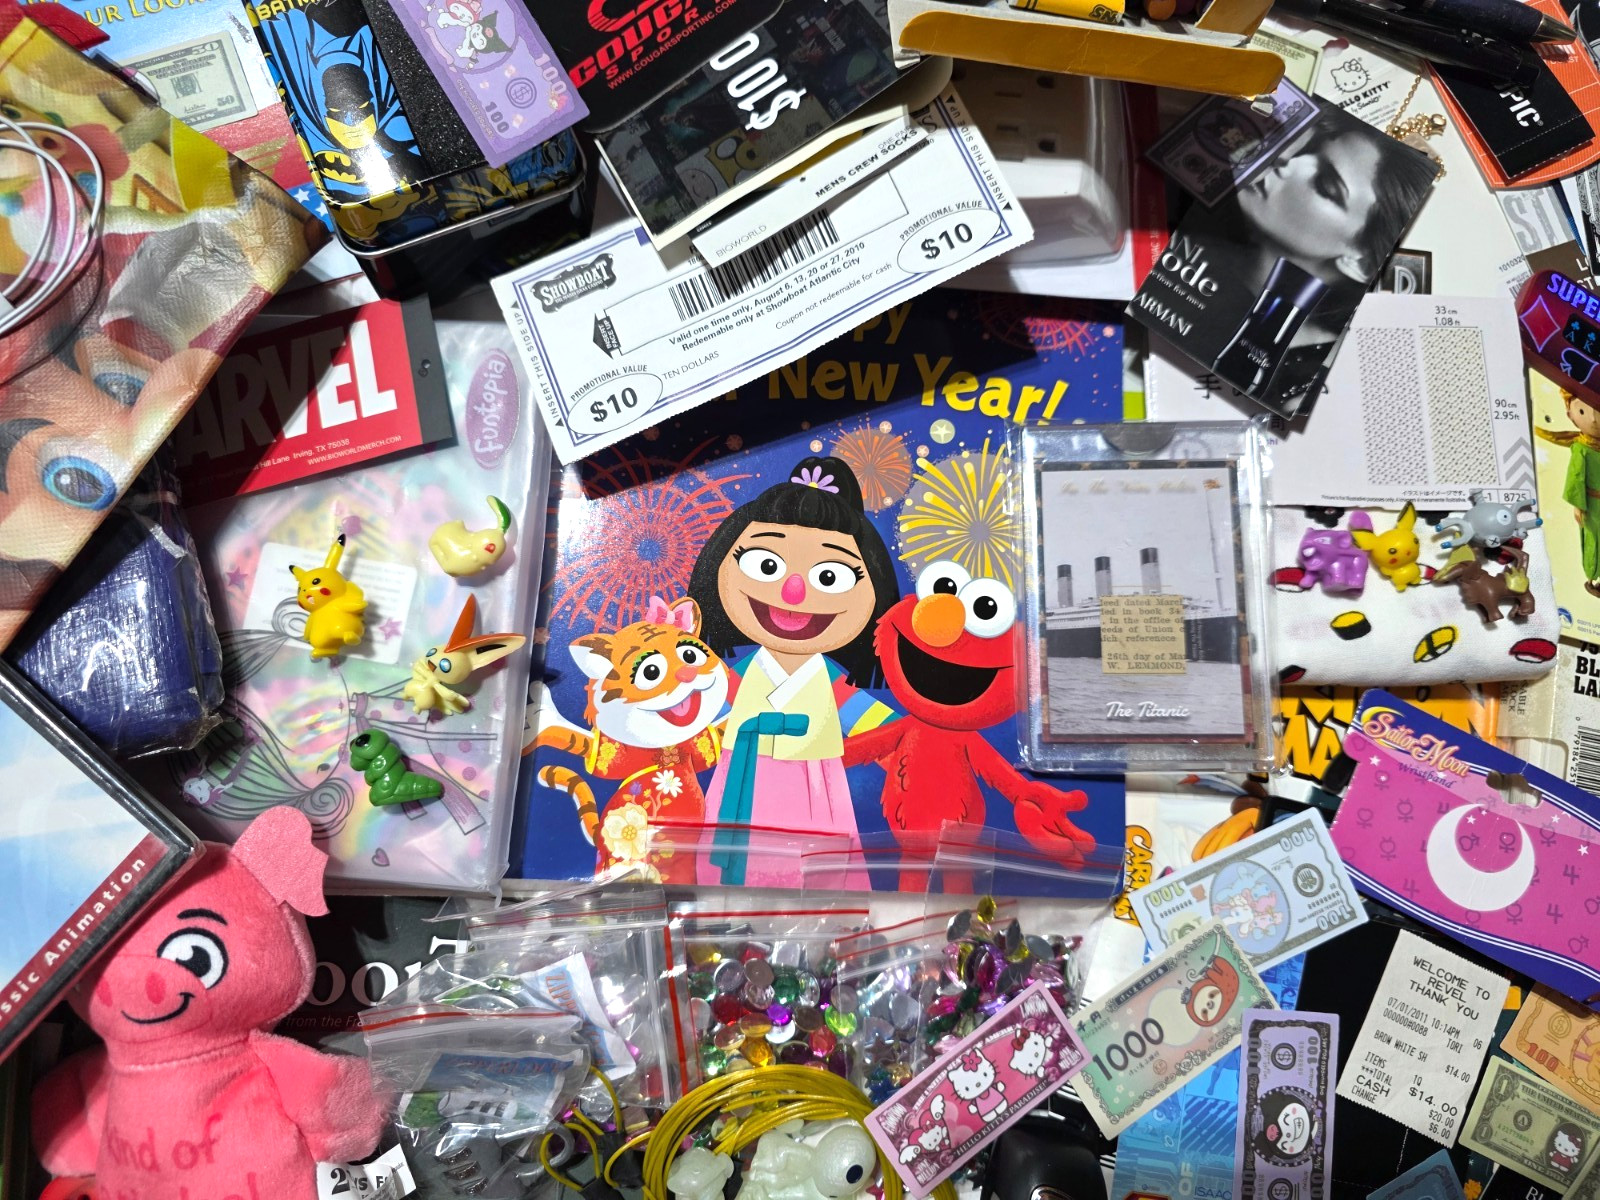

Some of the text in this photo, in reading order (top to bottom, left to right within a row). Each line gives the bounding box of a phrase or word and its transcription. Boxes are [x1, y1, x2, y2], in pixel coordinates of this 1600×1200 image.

[569, 0, 695, 89] COUG
[606, 0, 722, 80] SPOR
[607, 0, 738, 91] WWW.COUGARSPORTINC.COM
[534, 53, 567, 95] 100
[1362, 81, 1390, 99] KITTY
[485, 101, 510, 133] 100
[878, 135, 895, 149] ONE
[949, 105, 1007, 204] INSERT THIS SIDE UP
[815, 174, 847, 199] MENS
[848, 154, 880, 178] CREW
[880, 128, 919, 157] SOCKS
[898, 199, 984, 242] PROMOTIONAL VALUE
[715, 225, 767, 257] BIOWORLD
[919, 222, 974, 261] $10
[540, 259, 611, 306] SHOWBOAT
[668, 241, 866, 346] Valid one time only, August 13, 20 or 27, 2010
[775, 262, 893, 330] Coupon not redeemable for cash
[681, 257, 862, 352] Redeemable only at Showboat Atlantic City
[1132, 291, 1195, 337] ARMANI
[1434, 305, 1447, 315] 33
[1434, 317, 1454, 326] 1.08
[1565, 330, 1575, 343] A
[607, 329, 619, 349] FACE
[513, 312, 560, 419] INSERT THIS SIDE UP
[662, 350, 720, 380] TEN DOLLARS
[570, 363, 648, 402] PROMOTIONAL VALUE
[767, 352, 1071, 426] New Year!
[474, 359, 509, 453] Funtopia
[589, 386, 638, 423] $10
[259, 438, 350, 469] Hill Lane Irving, TX 75038
[307, 434, 403, 466] WWW.BIOWORLDMERCH.COM
[1503, 492, 1527, 503] 8725
[1121, 607, 1132, 616] in
[1138, 607, 1162, 616] book
[1123, 598, 1151, 606] dated
[1109, 616, 1171, 625] in the office
[1128, 625, 1139, 634] of
[1144, 624, 1174, 634] Union
[1106, 652, 1166, 663] 26th day of
[1106, 661, 1121, 670] W.
[1105, 700, 1192, 719] The Titanic
[1362, 713, 1419, 751] Sailor
[1411, 733, 1471, 778] Moon
[1397, 761, 1457, 789] Wristband
[43, 858, 147, 968] Animation
[1412, 955, 1491, 1001] WELCOME TO
[1426, 976, 1467, 1003] REVEL
[1409, 979, 1480, 1021] THANK YOU
[286, 1013, 342, 1027] from the
[1387, 996, 1461, 1039] 07/01/2011 10:14PM
[1091, 1017, 1165, 1082] 1000
[1307, 1036, 1319, 1065] 100
[1364, 1051, 1388, 1070] ITEMS
[1393, 1038, 1429, 1063] WHITE SH
[1446, 1038, 1464, 1054] TORI
[1472, 1038, 1483, 1051] 06
[1526, 1042, 1560, 1073] 100
[925, 1075, 946, 1098] UNITED
[1444, 1064, 1471, 1084] $14.00
[1351, 1085, 1451, 1140] CHANGE $6.00
[1356, 1074, 1455, 1129] CASH $20.00
[981, 1112, 1010, 1138] KITTY'S
[171, 1112, 224, 1171] of
